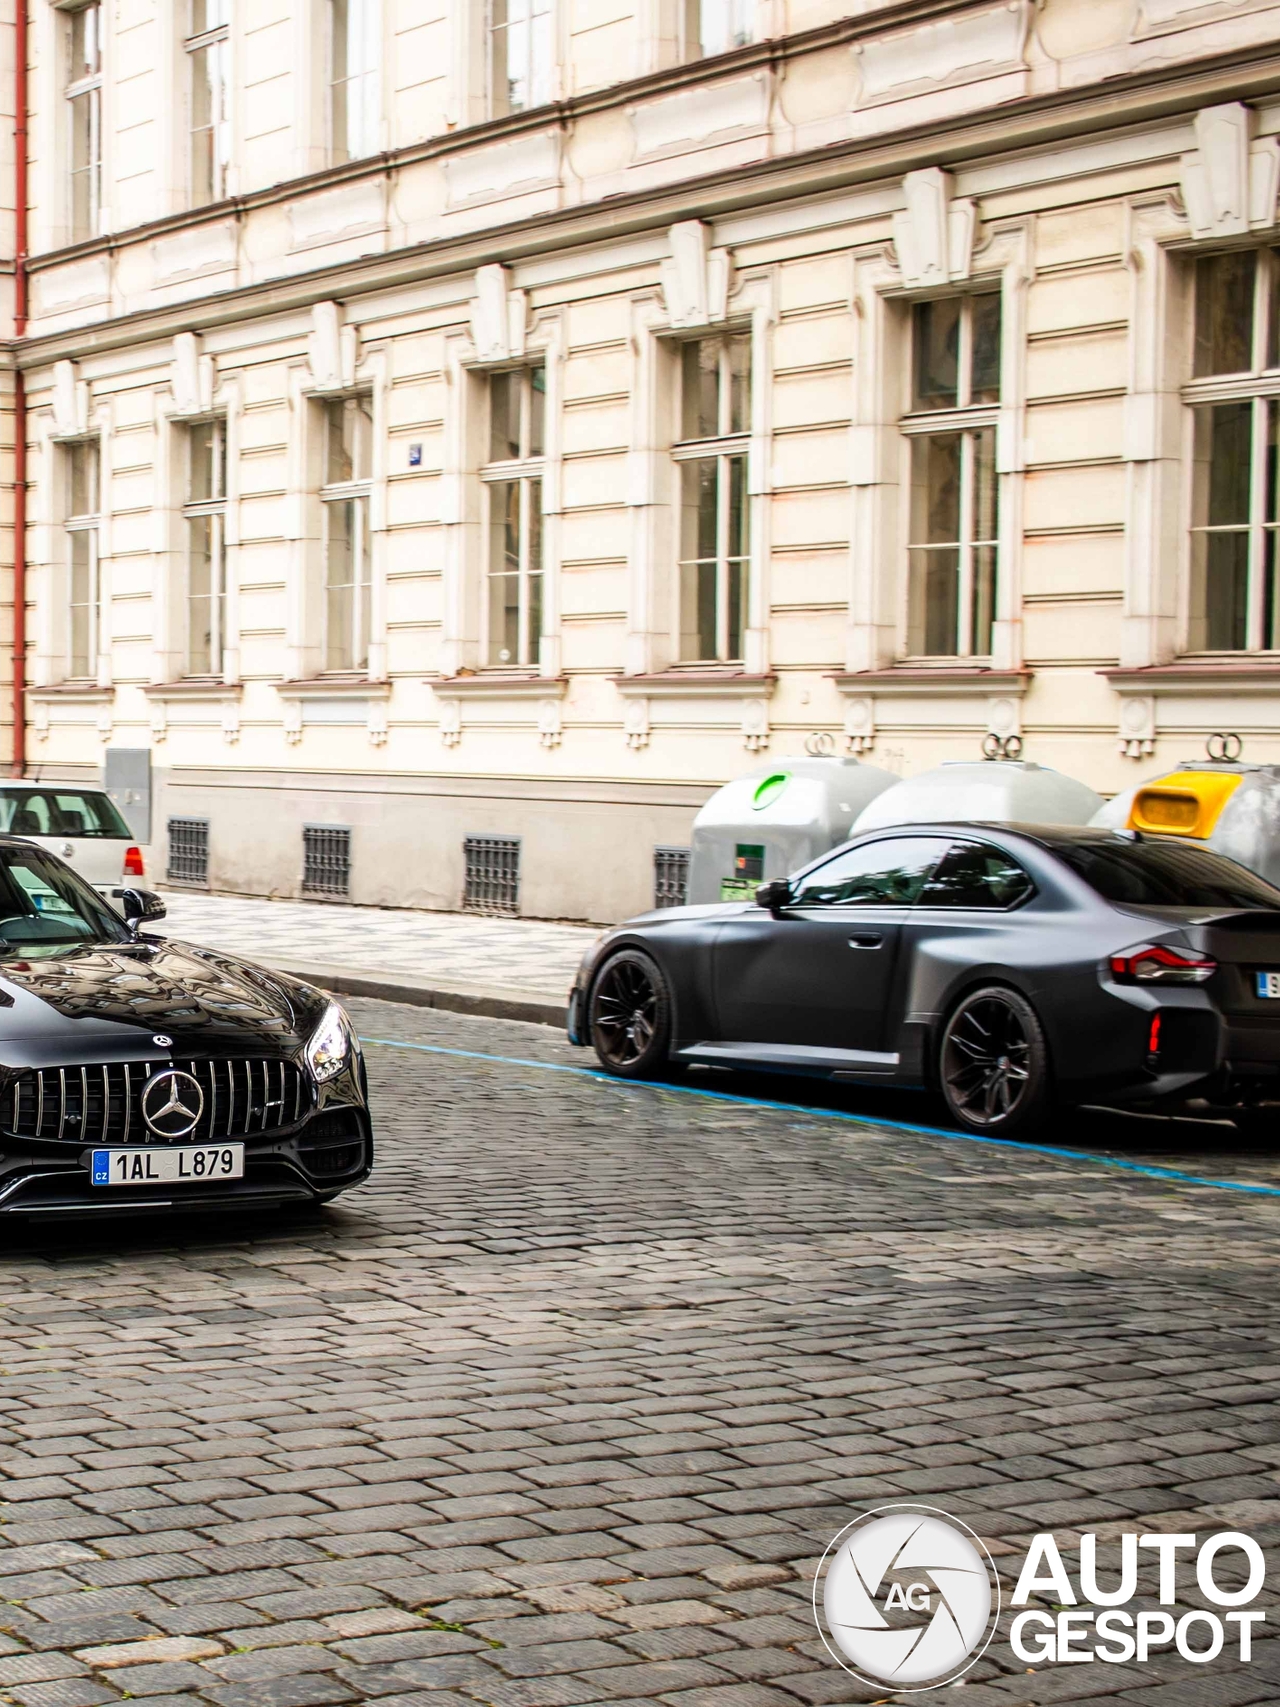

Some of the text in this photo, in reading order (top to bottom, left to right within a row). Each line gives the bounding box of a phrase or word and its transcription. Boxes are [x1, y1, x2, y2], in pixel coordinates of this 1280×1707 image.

[95, 1149, 233, 1181] CZ 1AL L879
